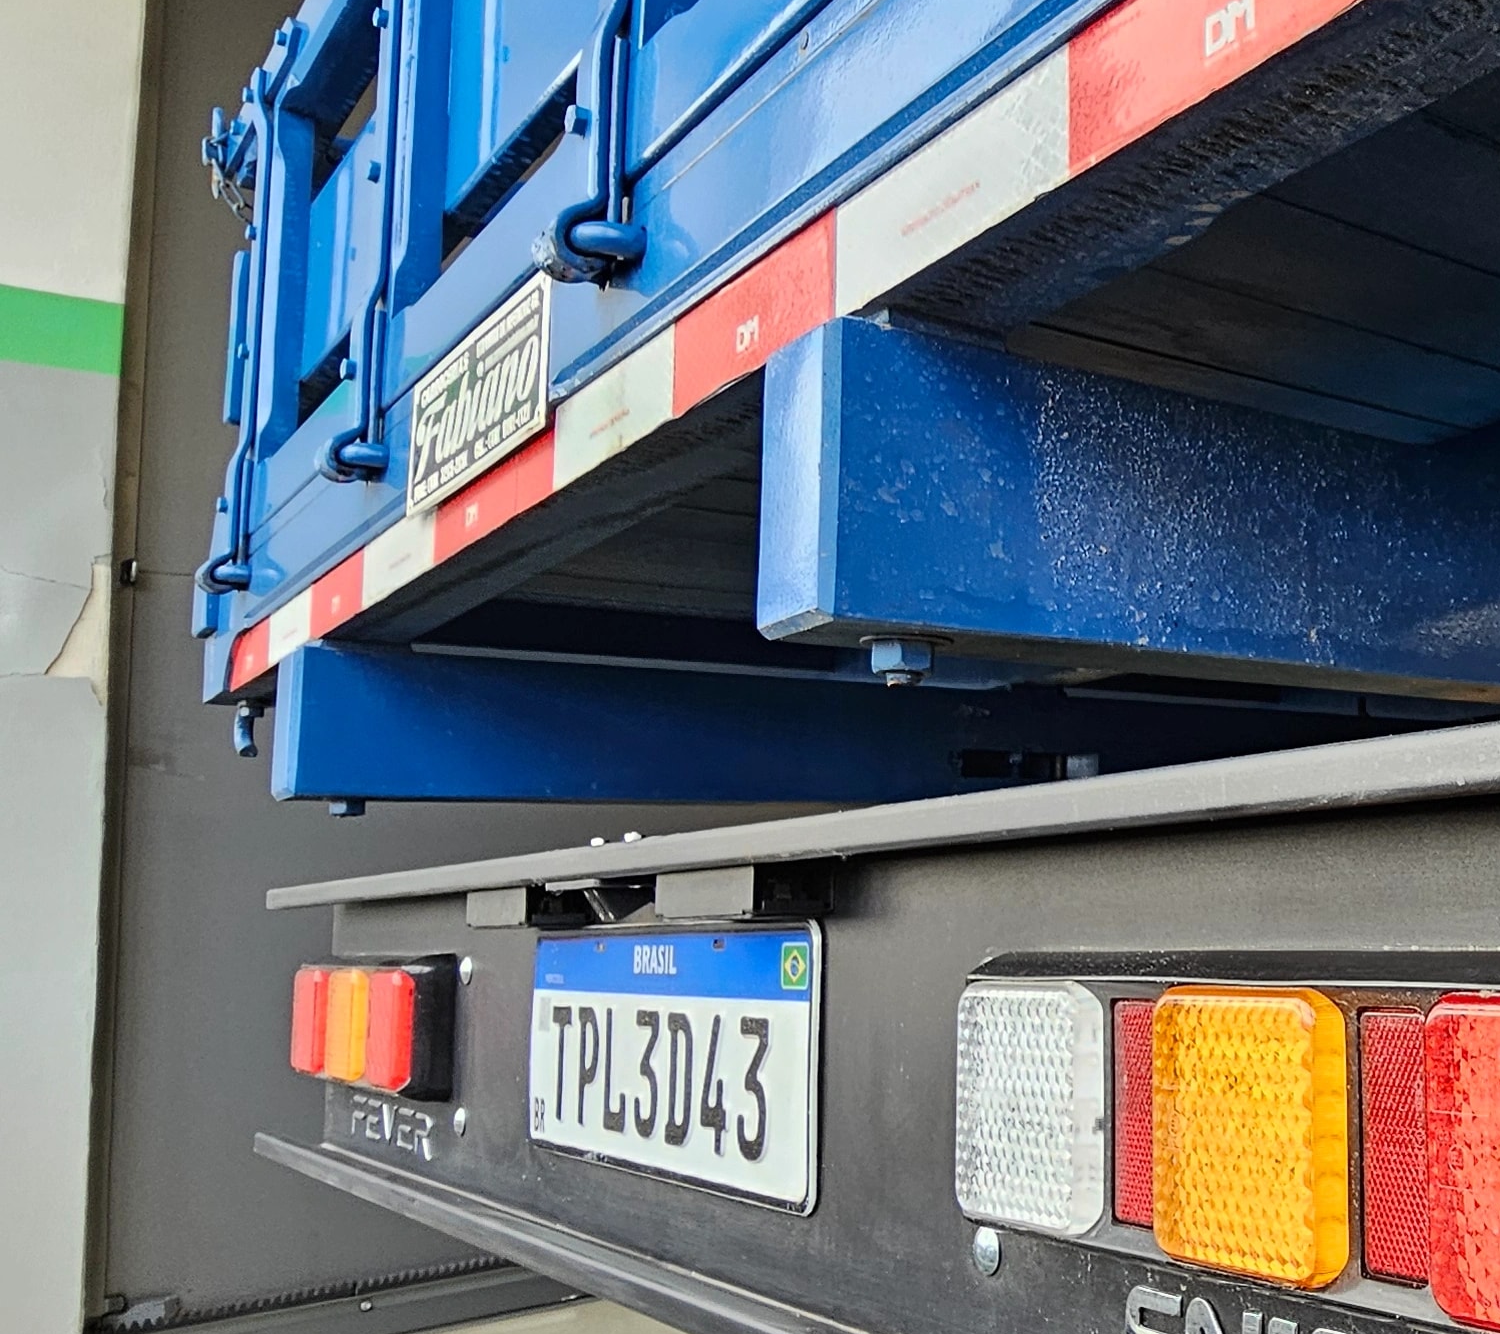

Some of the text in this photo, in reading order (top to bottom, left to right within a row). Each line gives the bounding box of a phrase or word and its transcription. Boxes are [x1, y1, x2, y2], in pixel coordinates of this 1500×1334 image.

[736, 315, 759, 353] DM
[414, 334, 539, 485] Fabiano
[633, 944, 678, 975] BRASIL
[552, 1005, 771, 1162] TPL3D43
[350, 1094, 434, 1161] FEVER
[534, 1097, 546, 1133] BR
